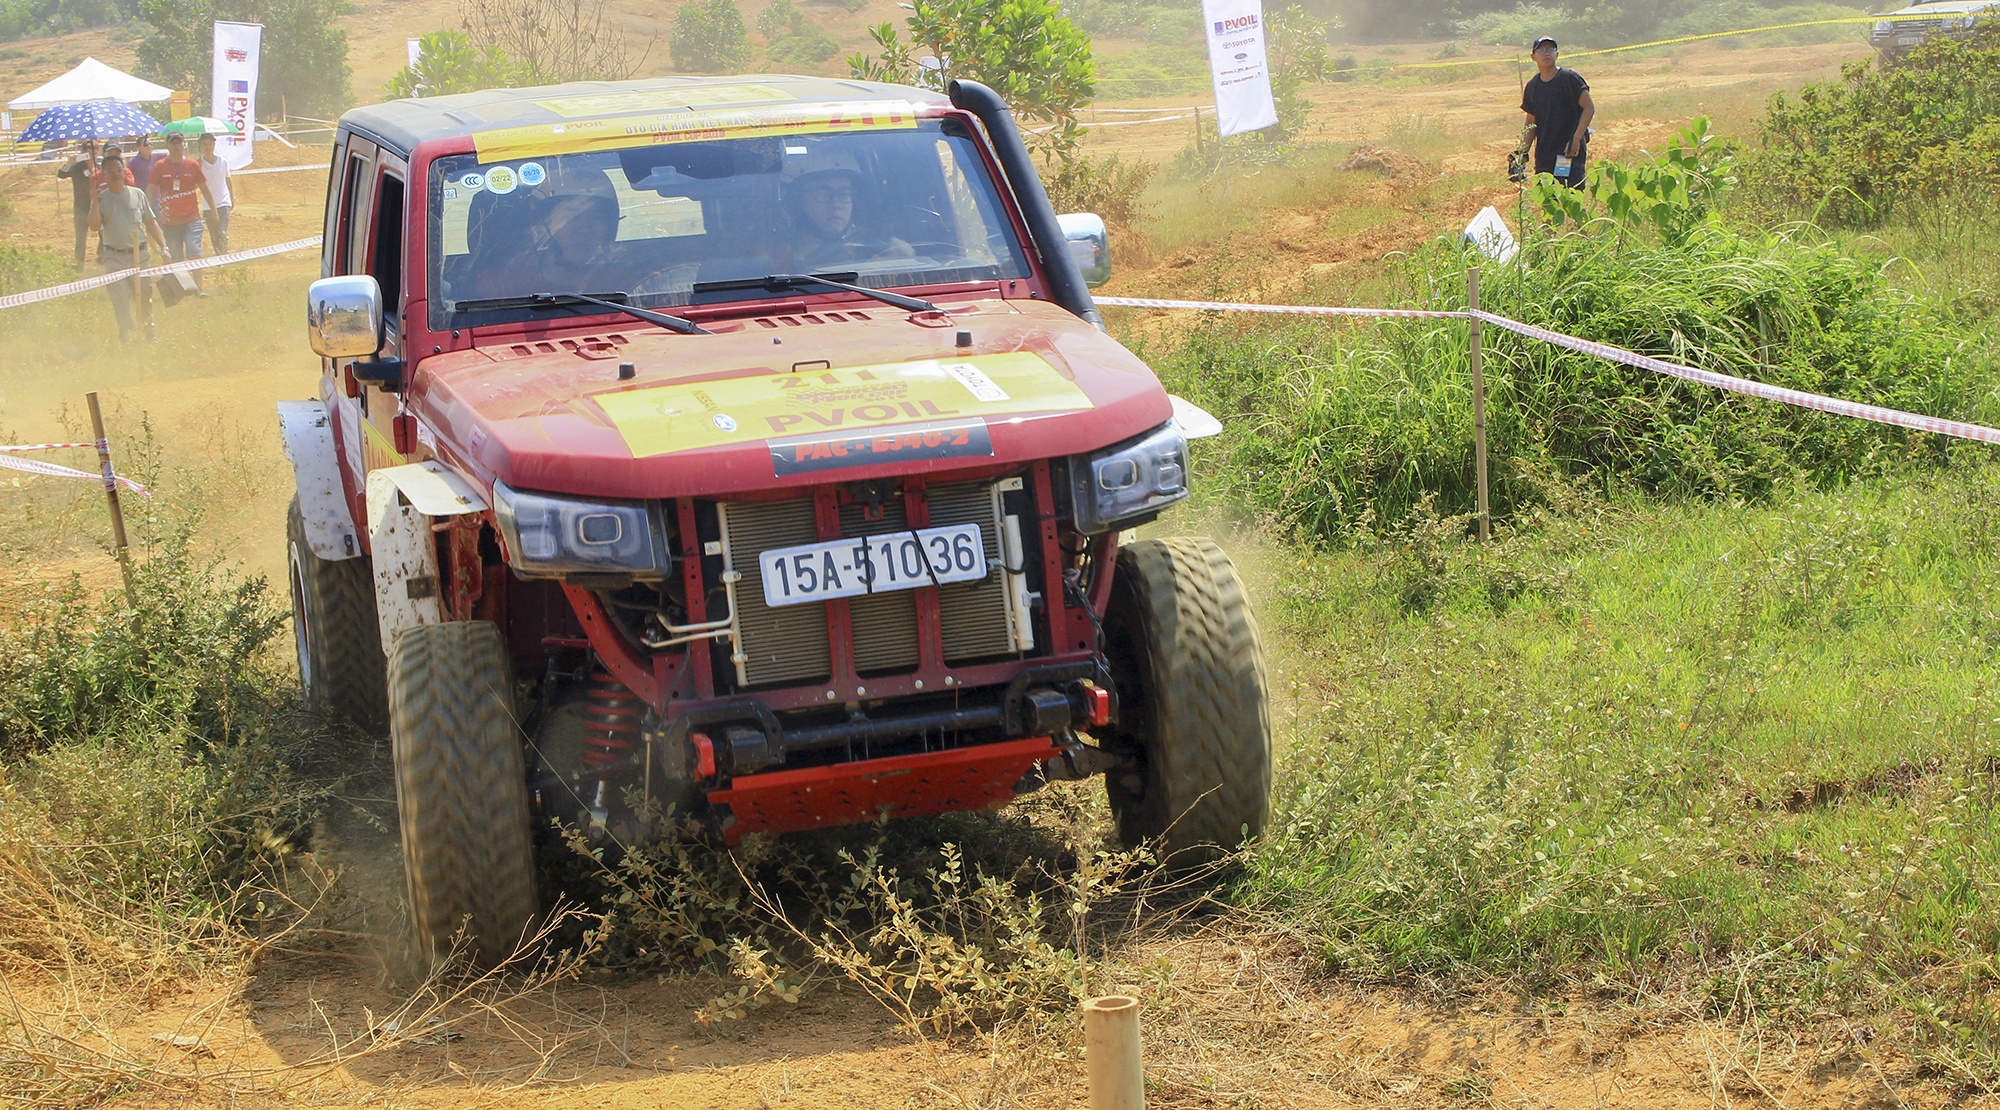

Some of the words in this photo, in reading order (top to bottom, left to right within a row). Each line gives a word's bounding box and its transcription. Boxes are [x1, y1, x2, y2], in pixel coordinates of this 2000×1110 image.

[1224, 14, 1258, 31] PVOIL
[1231, 37, 1256, 49] TOYOTA
[231, 97, 248, 147] PVOIL
[565, 120, 607, 130] PVOIL
[652, 132, 683, 144] PVOIL
[684, 130, 701, 140] CUP
[771, 369, 879, 390] 211
[951, 364, 988, 388] TOYOTA
[764, 399, 960, 433] PVOIL
[795, 440, 848, 463] PAC
[871, 427, 969, 455] BJ40-2
